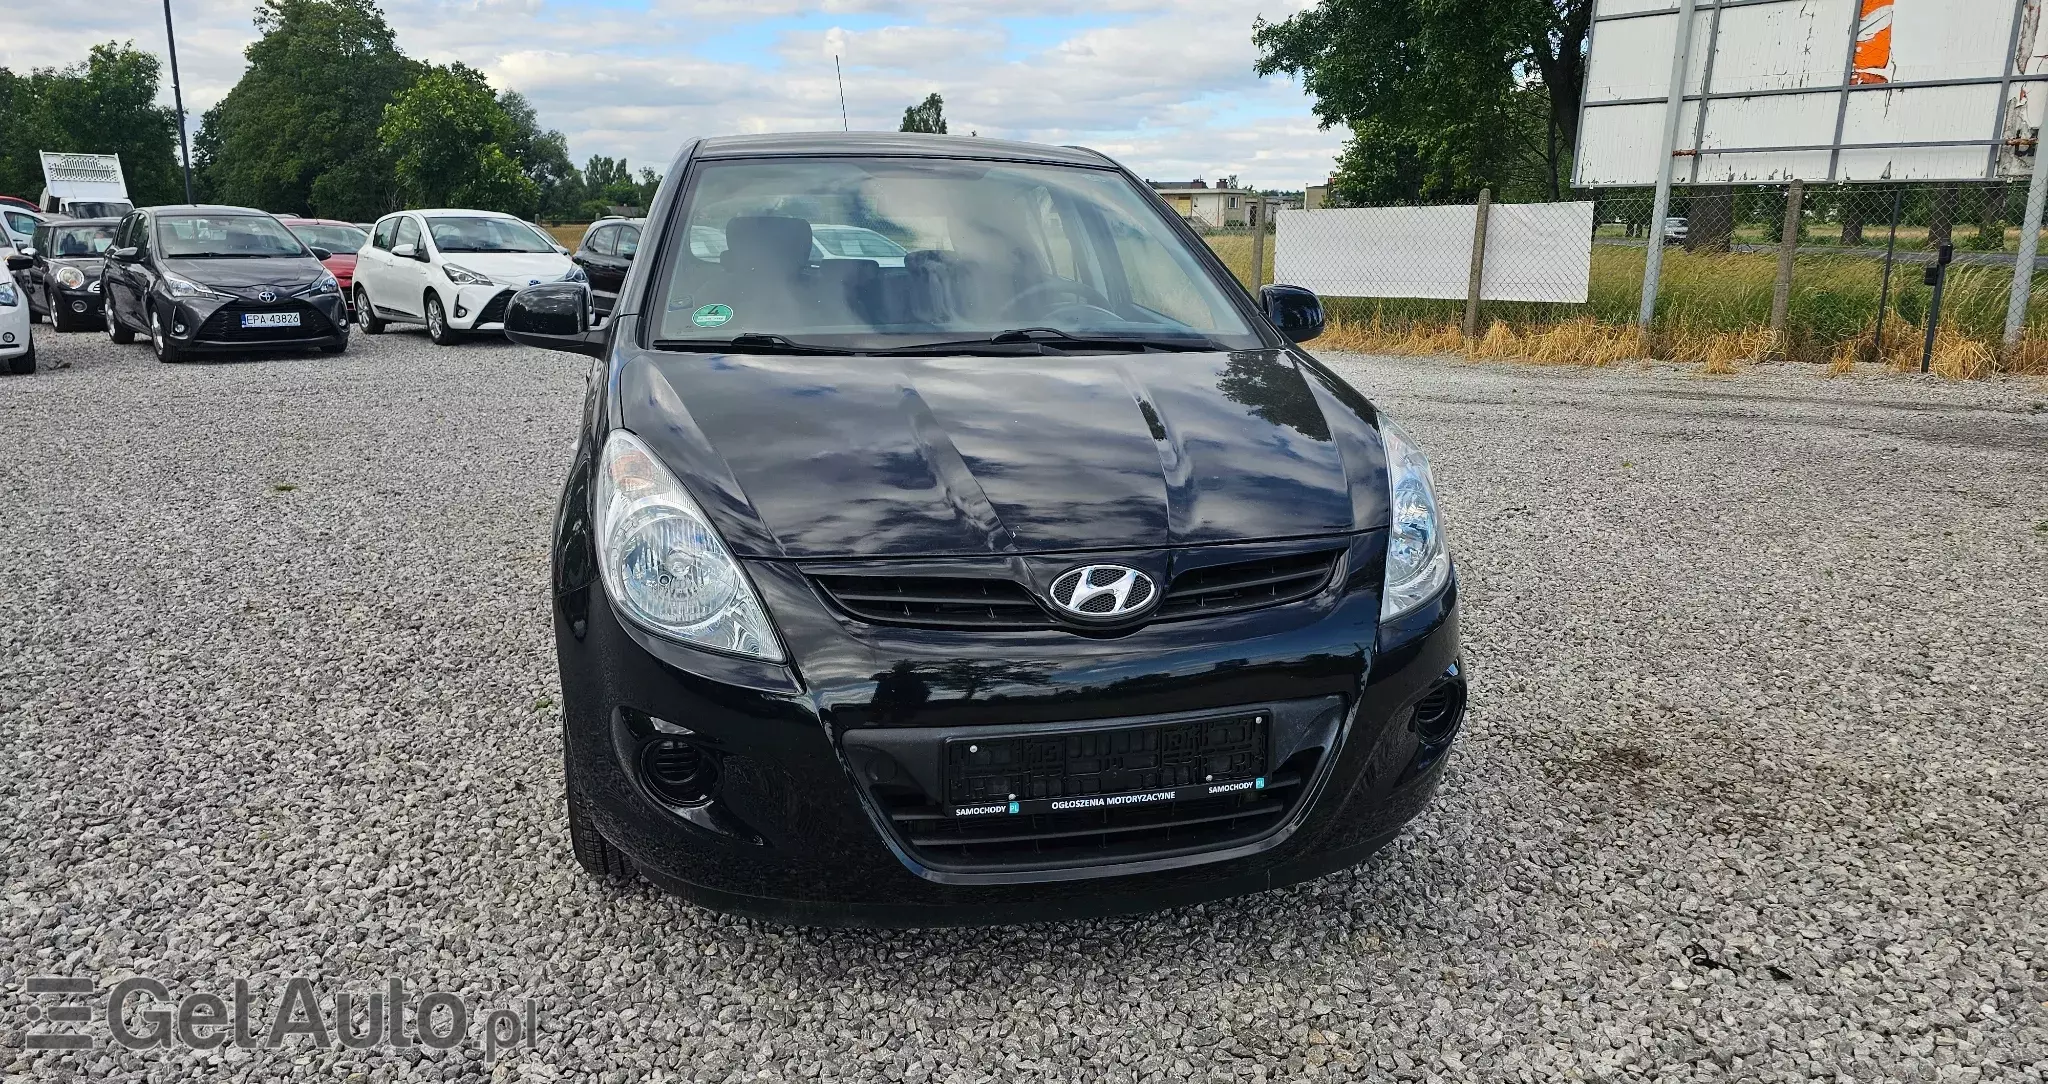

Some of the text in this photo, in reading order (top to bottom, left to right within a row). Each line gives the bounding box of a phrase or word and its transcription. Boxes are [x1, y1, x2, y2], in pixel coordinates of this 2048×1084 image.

[707, 305, 720, 316] 4
[246, 313, 299, 325] EPA 43826
[1208, 781, 1254, 794] SAMOCHODY
[1051, 791, 1176, 810] OGŁOSZENIA MOTORYZACYJNE
[955, 805, 1007, 816] SAMOCHODY
